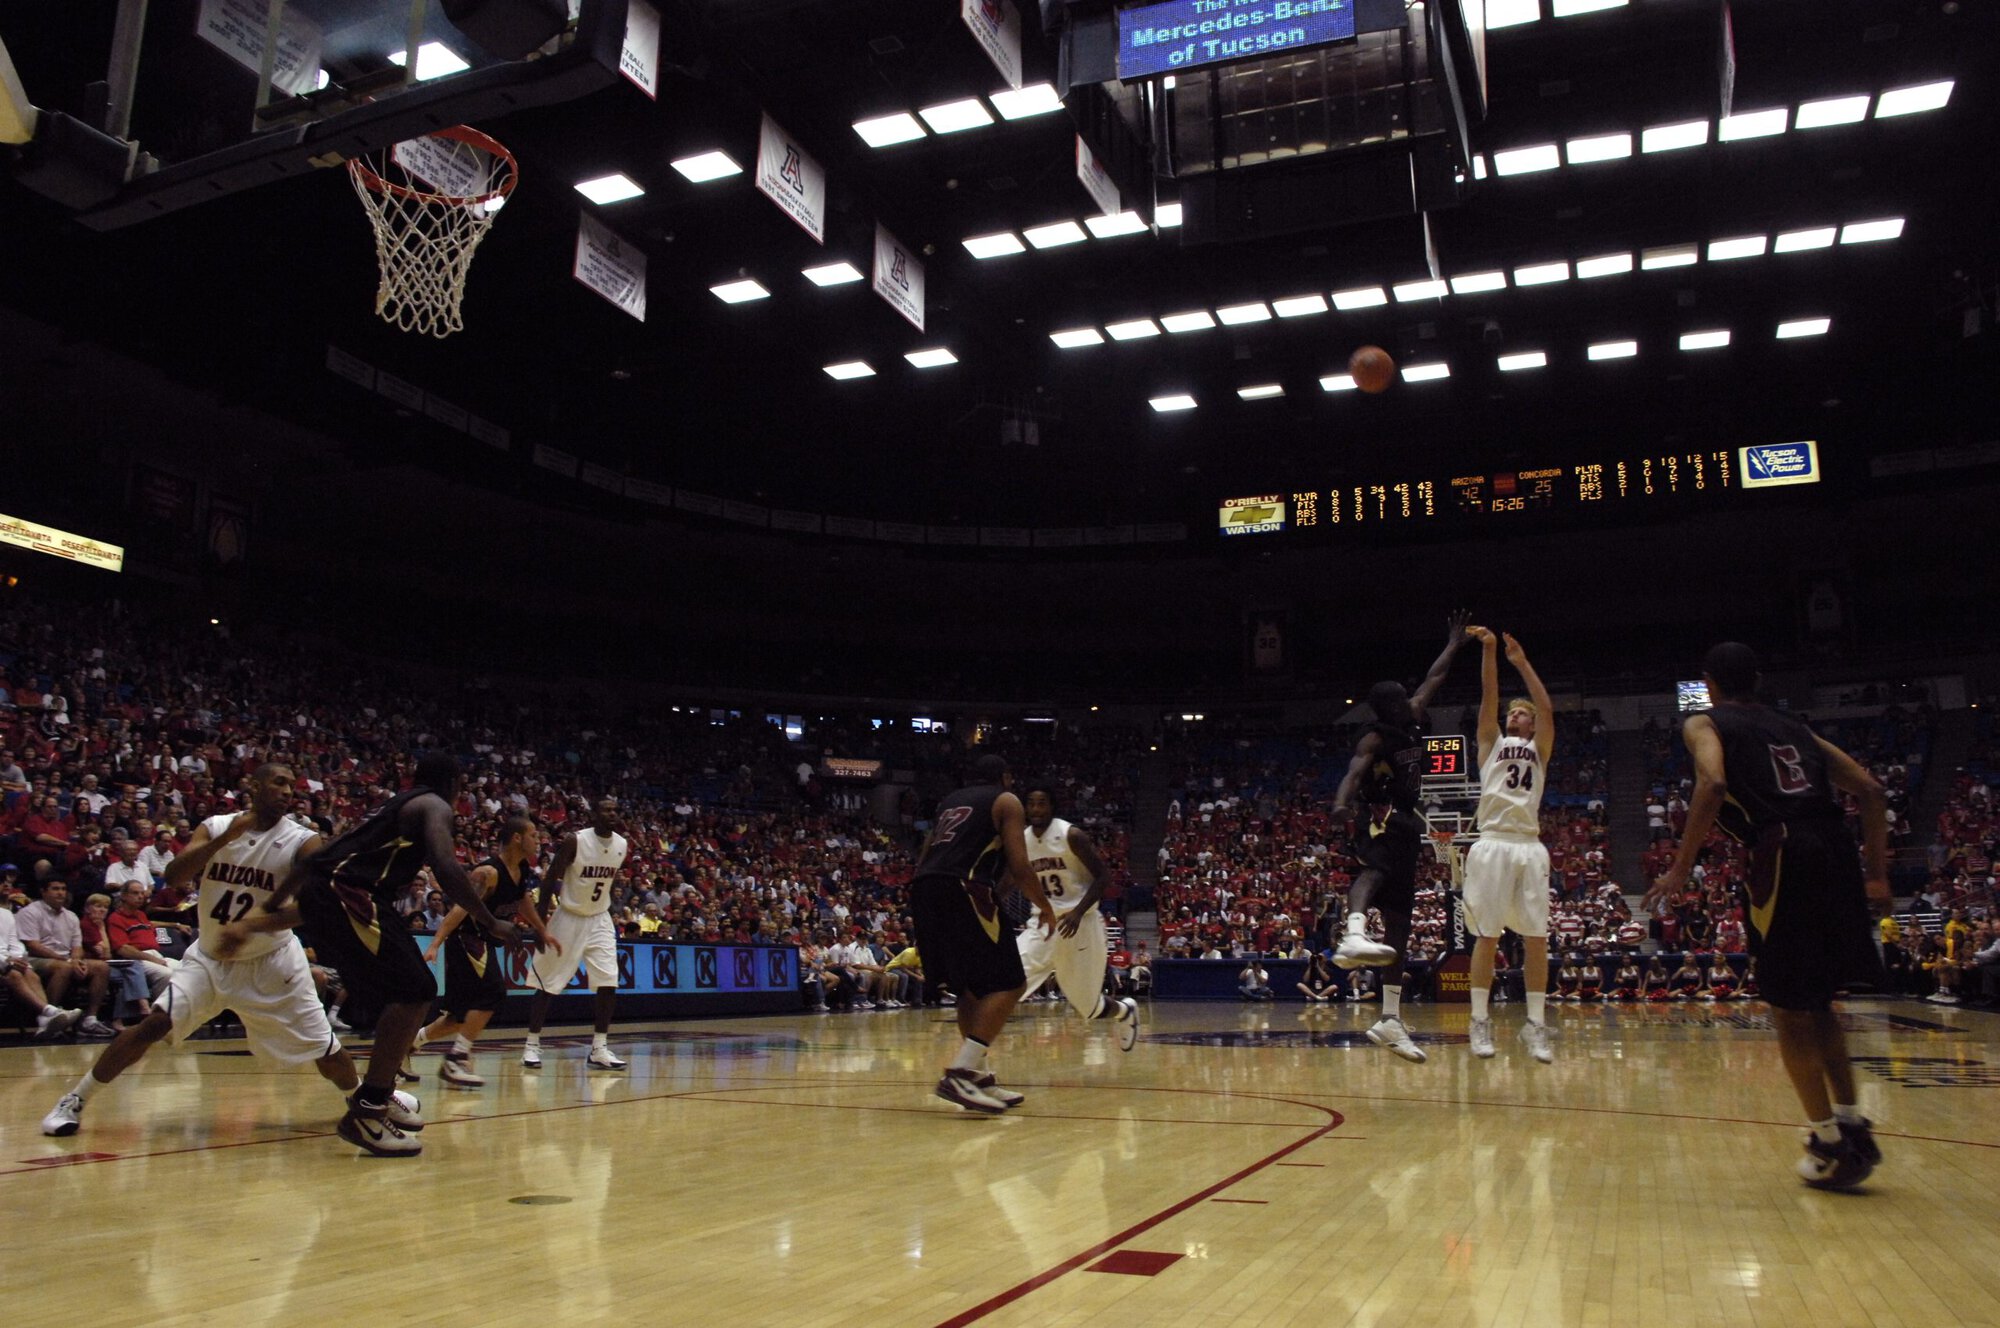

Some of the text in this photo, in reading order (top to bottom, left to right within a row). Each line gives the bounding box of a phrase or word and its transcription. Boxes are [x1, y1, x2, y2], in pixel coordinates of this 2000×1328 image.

[1132, 0, 1343, 47] Mercedes-Benz
[1168, 28, 1305, 66] of Tucson
[776, 192, 795, 212] SWEET
[796, 210, 818, 233] SIXTEEN
[1761, 449, 1796, 458] Tucson
[1766, 455, 1804, 465] Electric
[1575, 464, 1602, 474] PLYR
[1661, 457, 1676, 466] 10
[1687, 454, 1702, 464] 12
[1713, 452, 1728, 461] 15
[1770, 464, 1806, 474] Power
[1451, 476, 1485, 486] ARIZONA
[1519, 468, 1562, 480] CONCORDIA
[1580, 473, 1599, 482] PTS
[1668, 466, 1677, 474] 7
[1580, 482, 1602, 492] RBS
[1721, 470, 1730, 478] 2
[1332, 489, 1339, 498] 0
[1370, 486, 1385, 494] 34
[1394, 484, 1408, 492] 42
[1418, 482, 1432, 490] 43
[1462, 486, 1479, 499] 42
[1535, 480, 1552, 493] 25
[1580, 491, 1602, 500] FLS
[1645, 486, 1653, 494] 0
[1696, 481, 1704, 489] 0
[1224, 494, 1280, 508] O'RIELLY
[1297, 501, 1315, 510] PTS
[1419, 490, 1433, 499] 12
[1492, 497, 1524, 512] 15:26
[1296, 509, 1316, 518] RBS
[1332, 515, 1340, 523] 0
[1355, 512, 1363, 520] 0
[1402, 509, 1410, 517] 0
[1426, 507, 1434, 515] 2
[1225, 523, 1280, 535] WATSON
[62, 540, 90, 552] DESERT
[1427, 740, 1460, 752] 15:26
[1430, 754, 1458, 773] 33
[1506, 764, 1532, 791] 34
[207, 862, 274, 892] ARIZONA
[592, 882, 604, 901] 5
[210, 890, 254, 925] 42
[1453, 896, 1465, 950] ARIZONA
